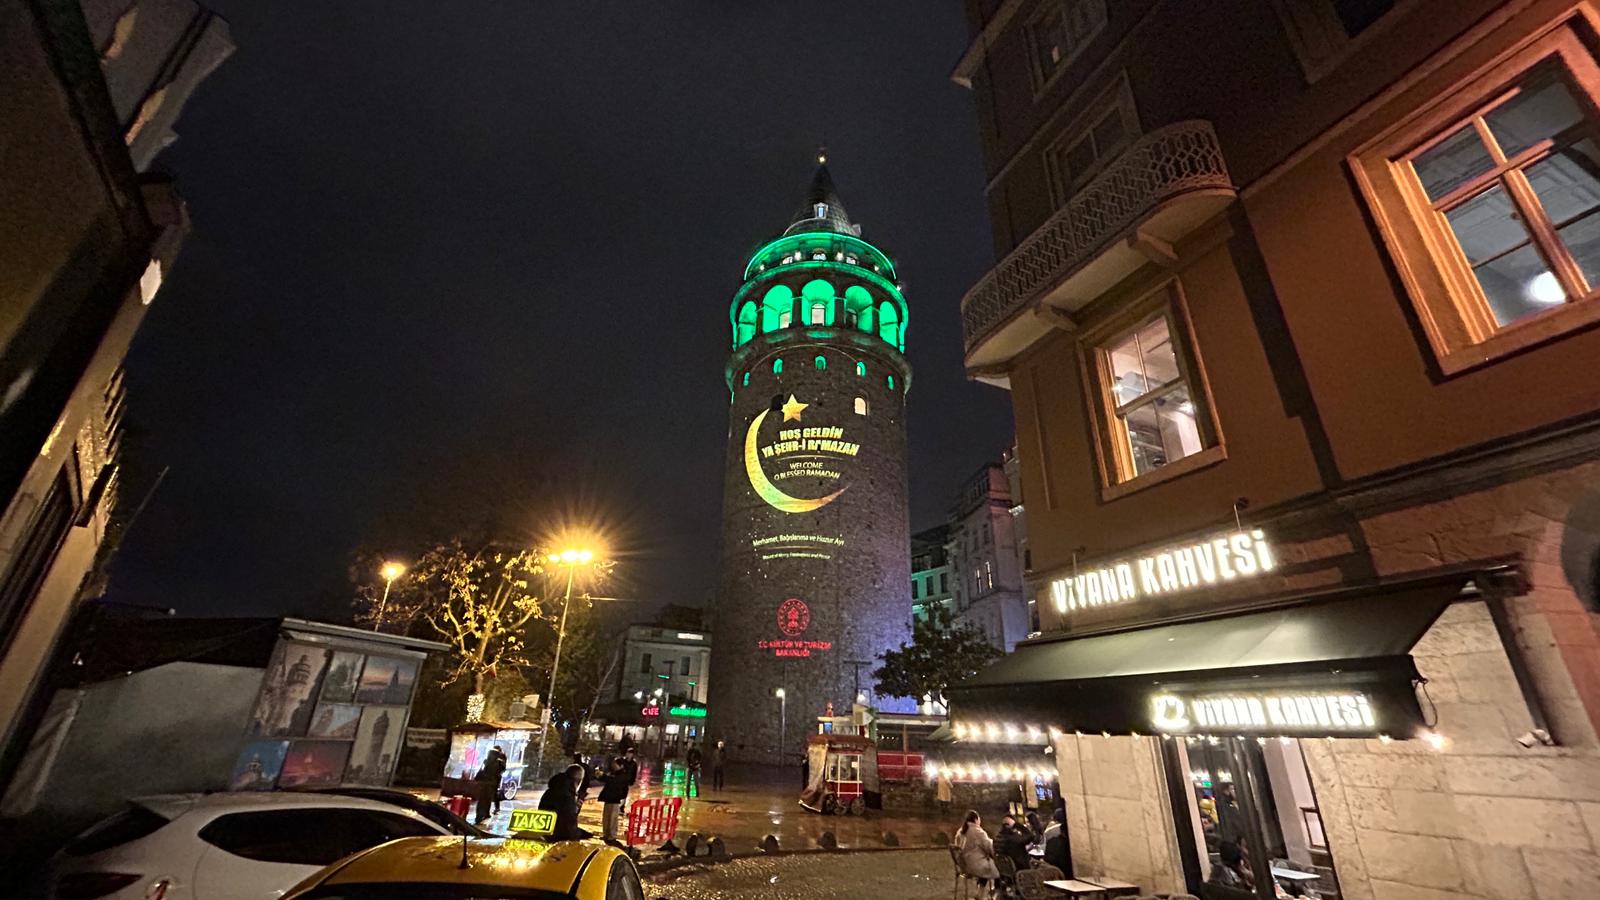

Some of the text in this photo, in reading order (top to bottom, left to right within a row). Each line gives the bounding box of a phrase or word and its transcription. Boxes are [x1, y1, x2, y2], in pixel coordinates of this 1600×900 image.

[761, 445, 774, 458] YA
[789, 461, 824, 470] WELCOME
[780, 469, 806, 479] BLESSED
[806, 468, 841, 479] RAMADAN
[795, 640, 804, 648] VE
